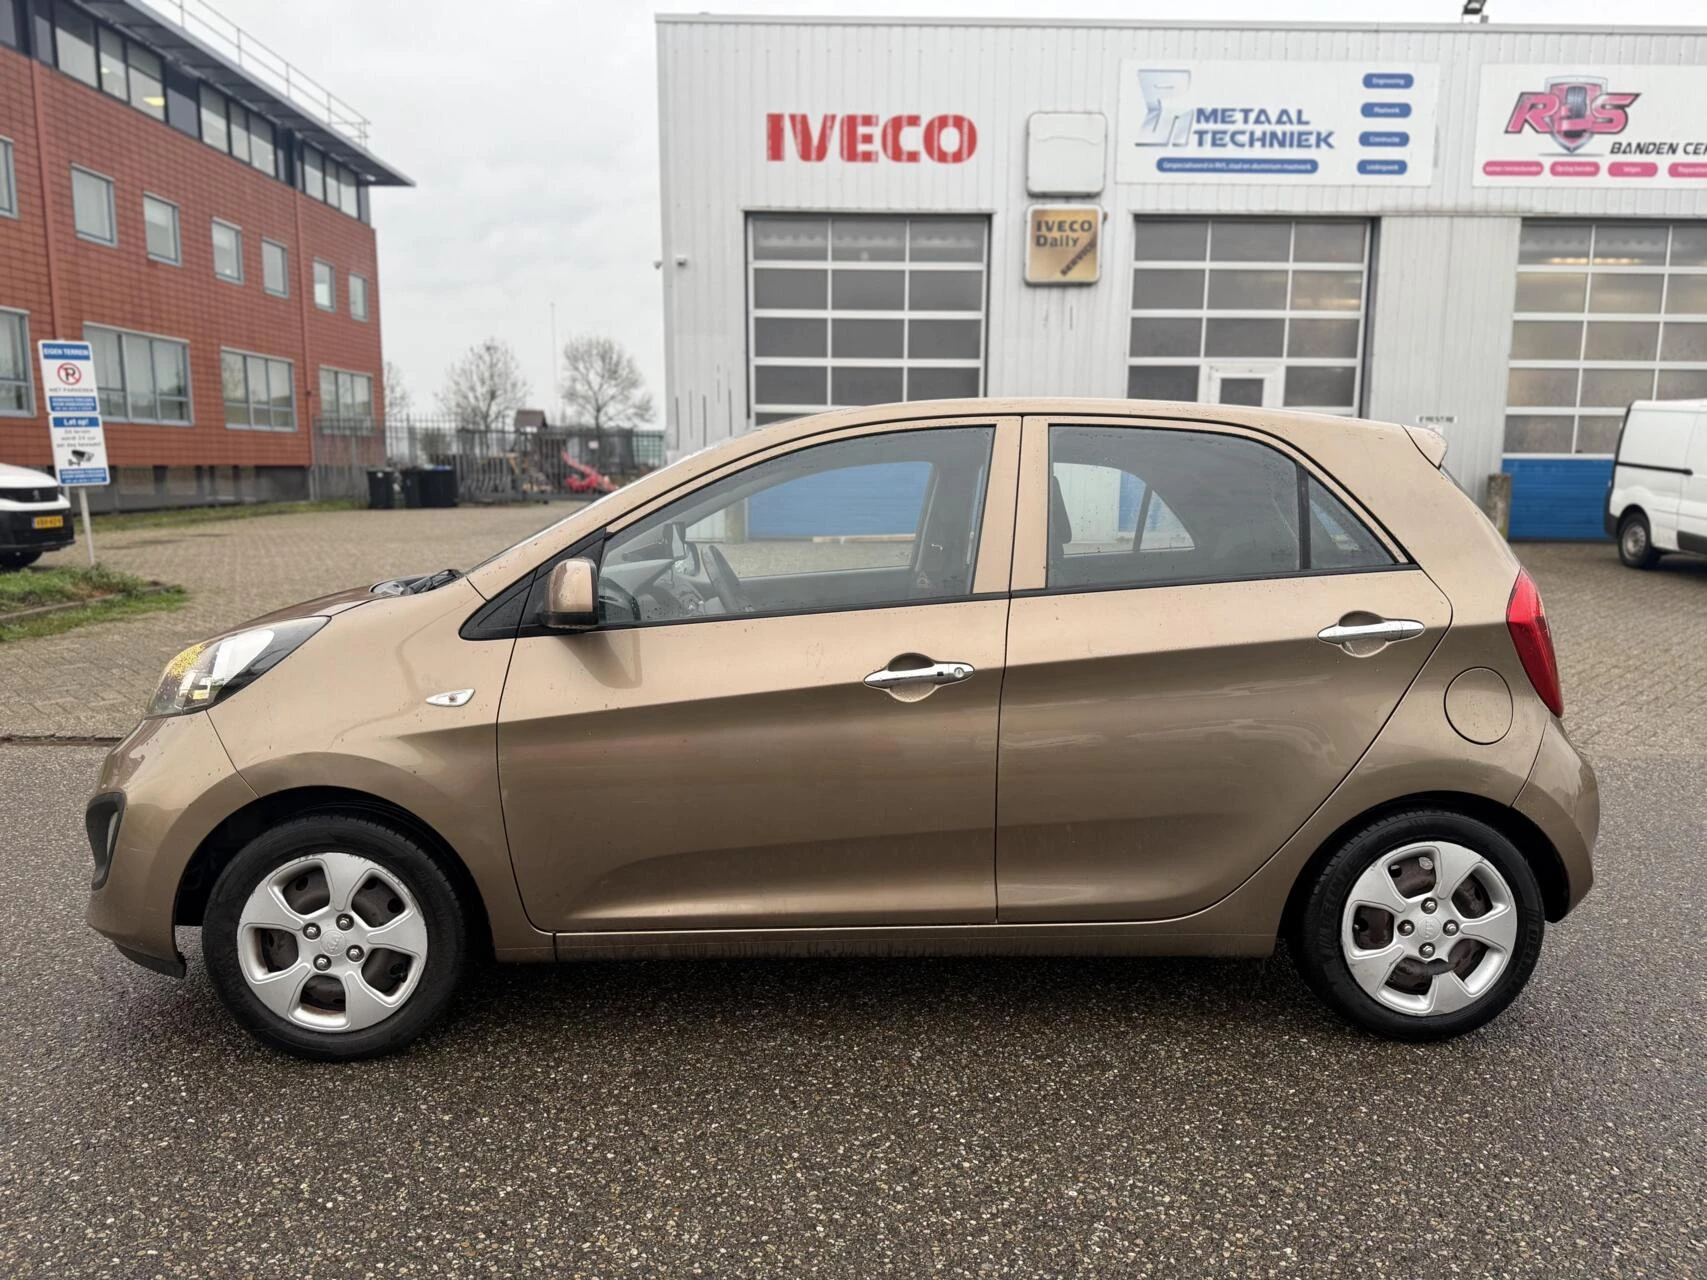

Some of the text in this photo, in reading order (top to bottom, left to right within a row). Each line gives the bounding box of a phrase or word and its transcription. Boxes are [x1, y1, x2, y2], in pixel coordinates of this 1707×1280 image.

[1195, 108, 1311, 126] METAAL
[767, 113, 978, 164] IVECO
[1194, 130, 1335, 149] TECHNIEK
[1610, 141, 1679, 155] BANDEN
[1035, 219, 1093, 233] IVECO
[1035, 234, 1079, 248] Daily
